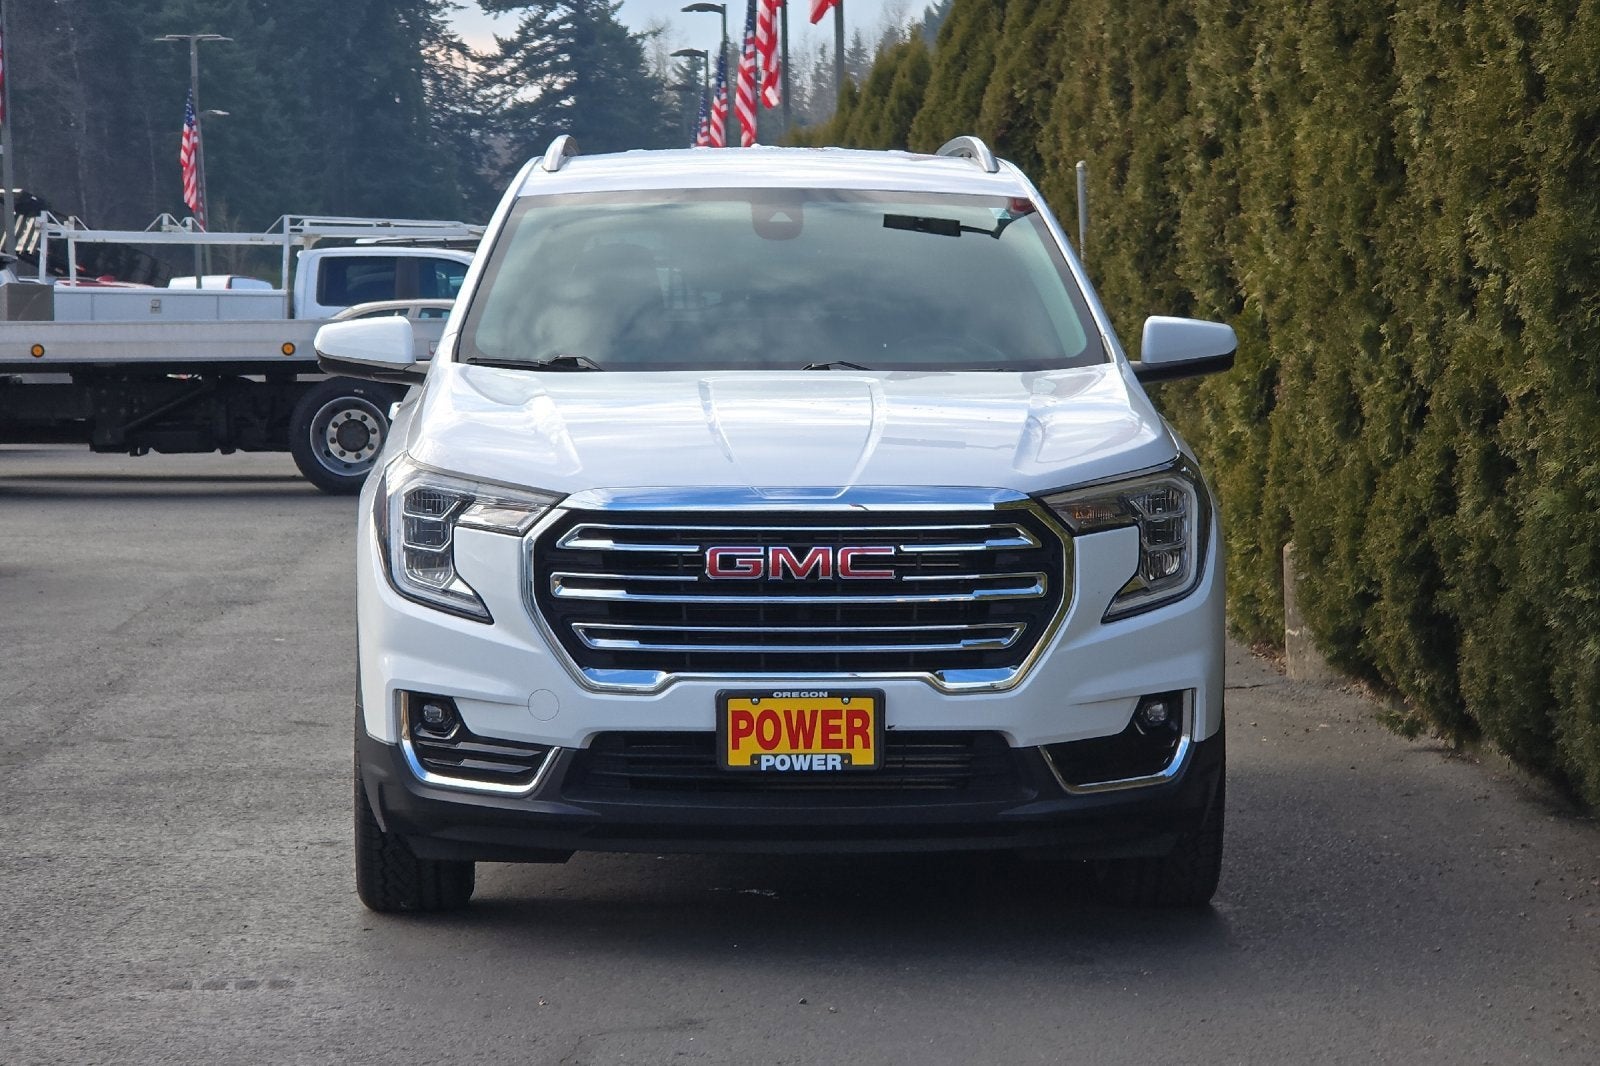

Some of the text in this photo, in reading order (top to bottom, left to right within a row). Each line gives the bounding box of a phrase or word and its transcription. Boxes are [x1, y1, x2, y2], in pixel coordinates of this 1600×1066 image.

[705, 546, 896, 580] GMC
[731, 709, 871, 750] POWER
[760, 754, 842, 771] POWER
